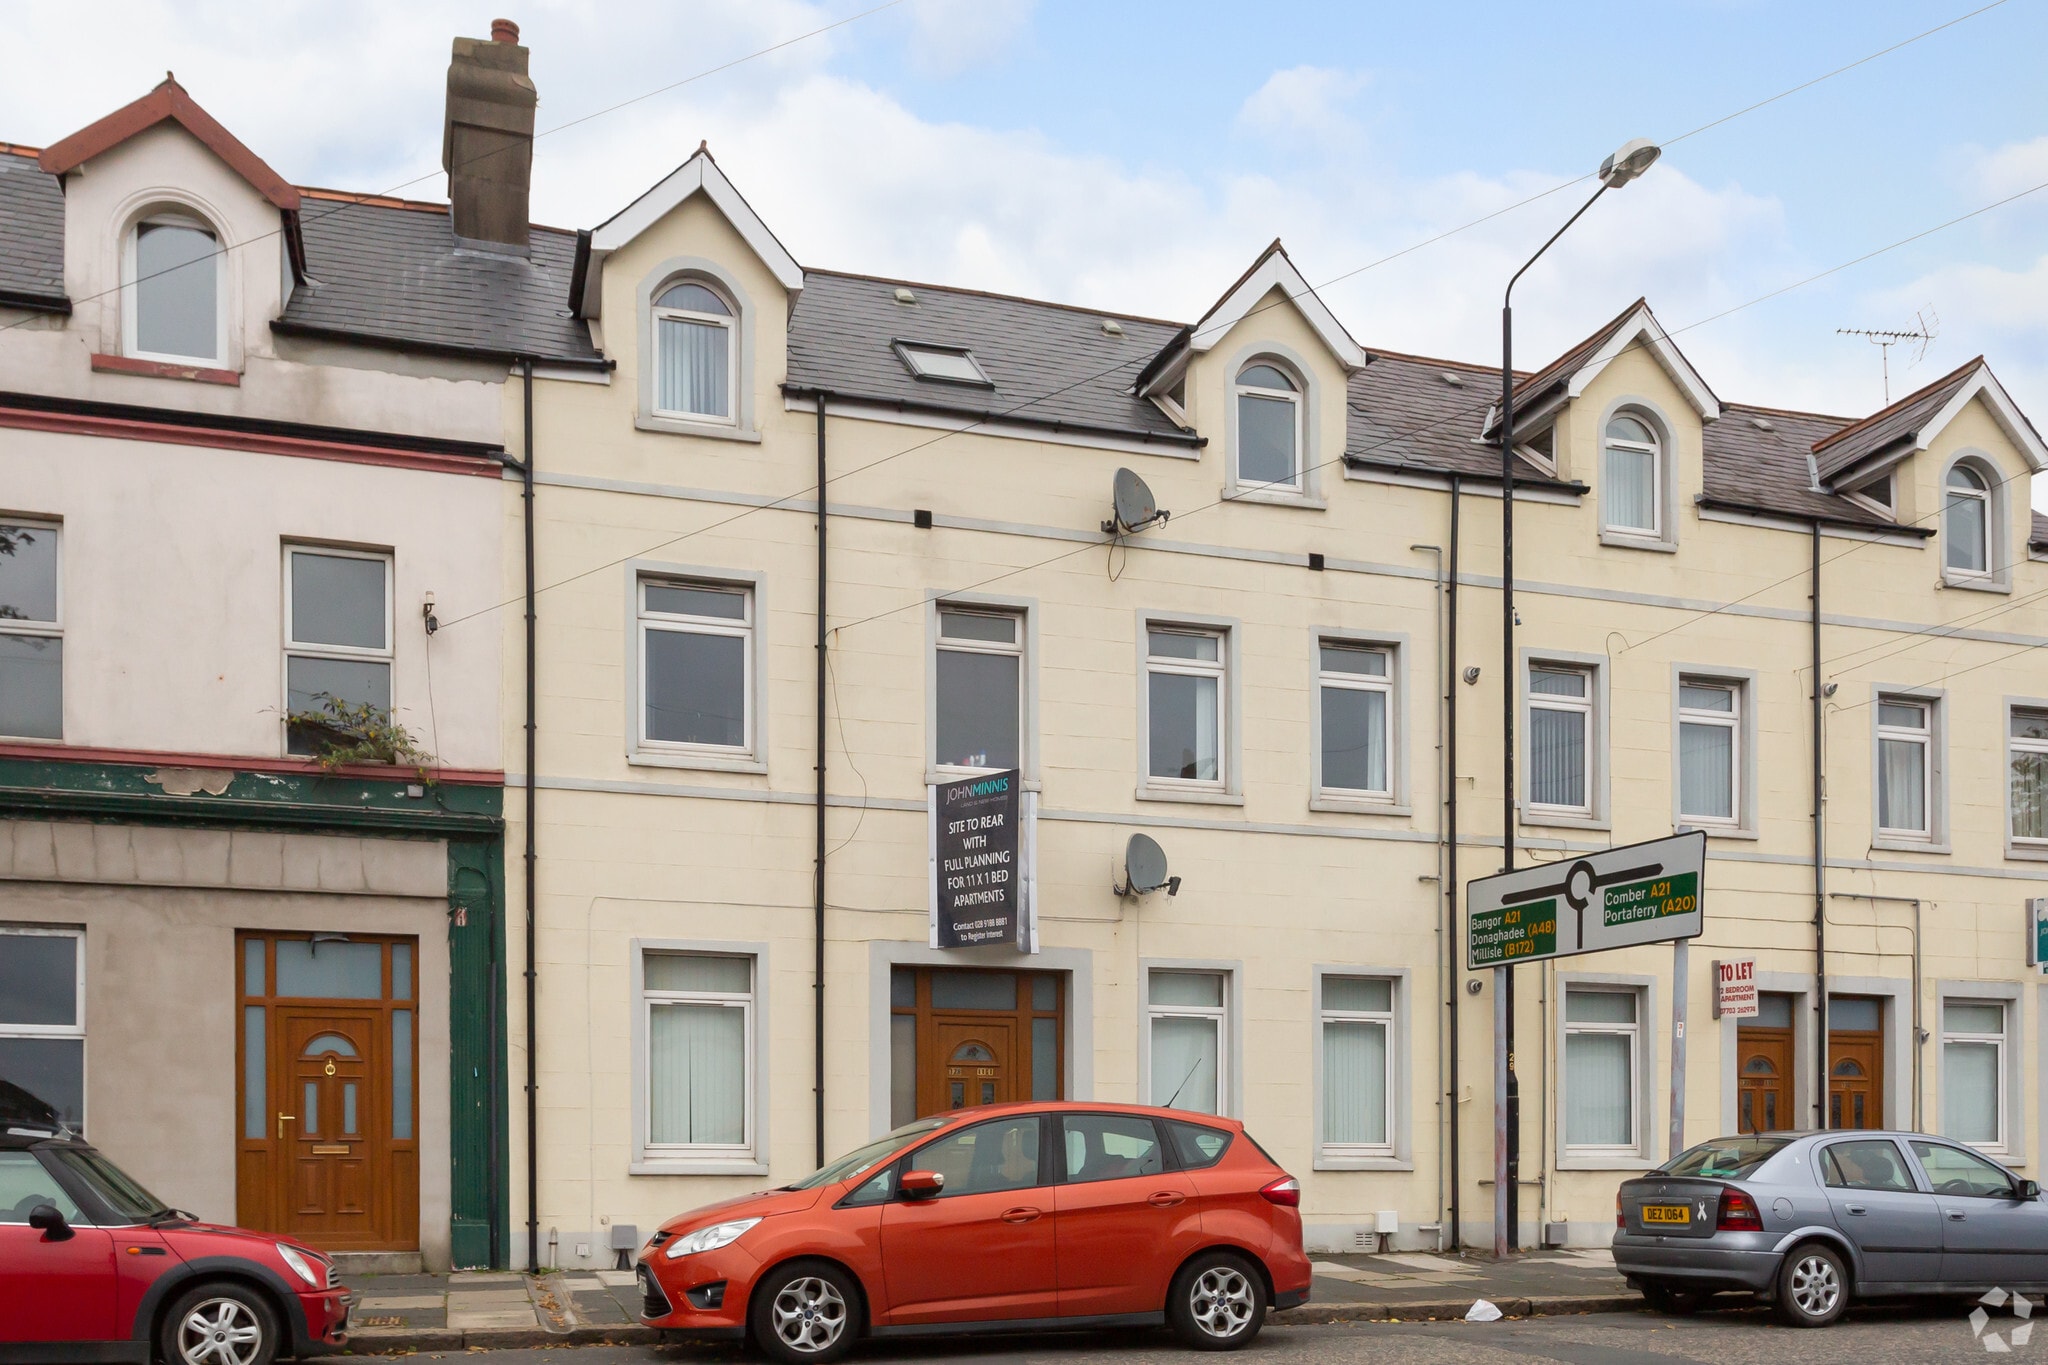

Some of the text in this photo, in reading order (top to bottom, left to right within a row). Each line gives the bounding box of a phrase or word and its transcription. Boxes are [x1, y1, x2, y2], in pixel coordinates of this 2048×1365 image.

[948, 813, 1004, 835] SITE TO REAR
[962, 834, 987, 850] WITH
[944, 850, 1010, 872] FULL PLANNING
[947, 869, 1009, 890] FOR 11 X 1 BED
[953, 888, 1005, 907] APARTMENTS
[1605, 881, 1671, 906] Comber A21
[1604, 895, 1696, 923] Portaferry (A20)
[952, 922, 974, 931] Contact
[1471, 910, 1521, 930] Bangor A21
[967, 932, 986, 942] Register
[1471, 919, 1556, 945] Donaghadee (A48)
[1471, 939, 1534, 961] Millisle (B172)
[1720, 962, 1753, 981] TO LET
[1721, 994, 1754, 1003] APARTMENT
[1726, 985, 1754, 994] BEDROOM
[1647, 1207, 1684, 1221] DEZ 1064
